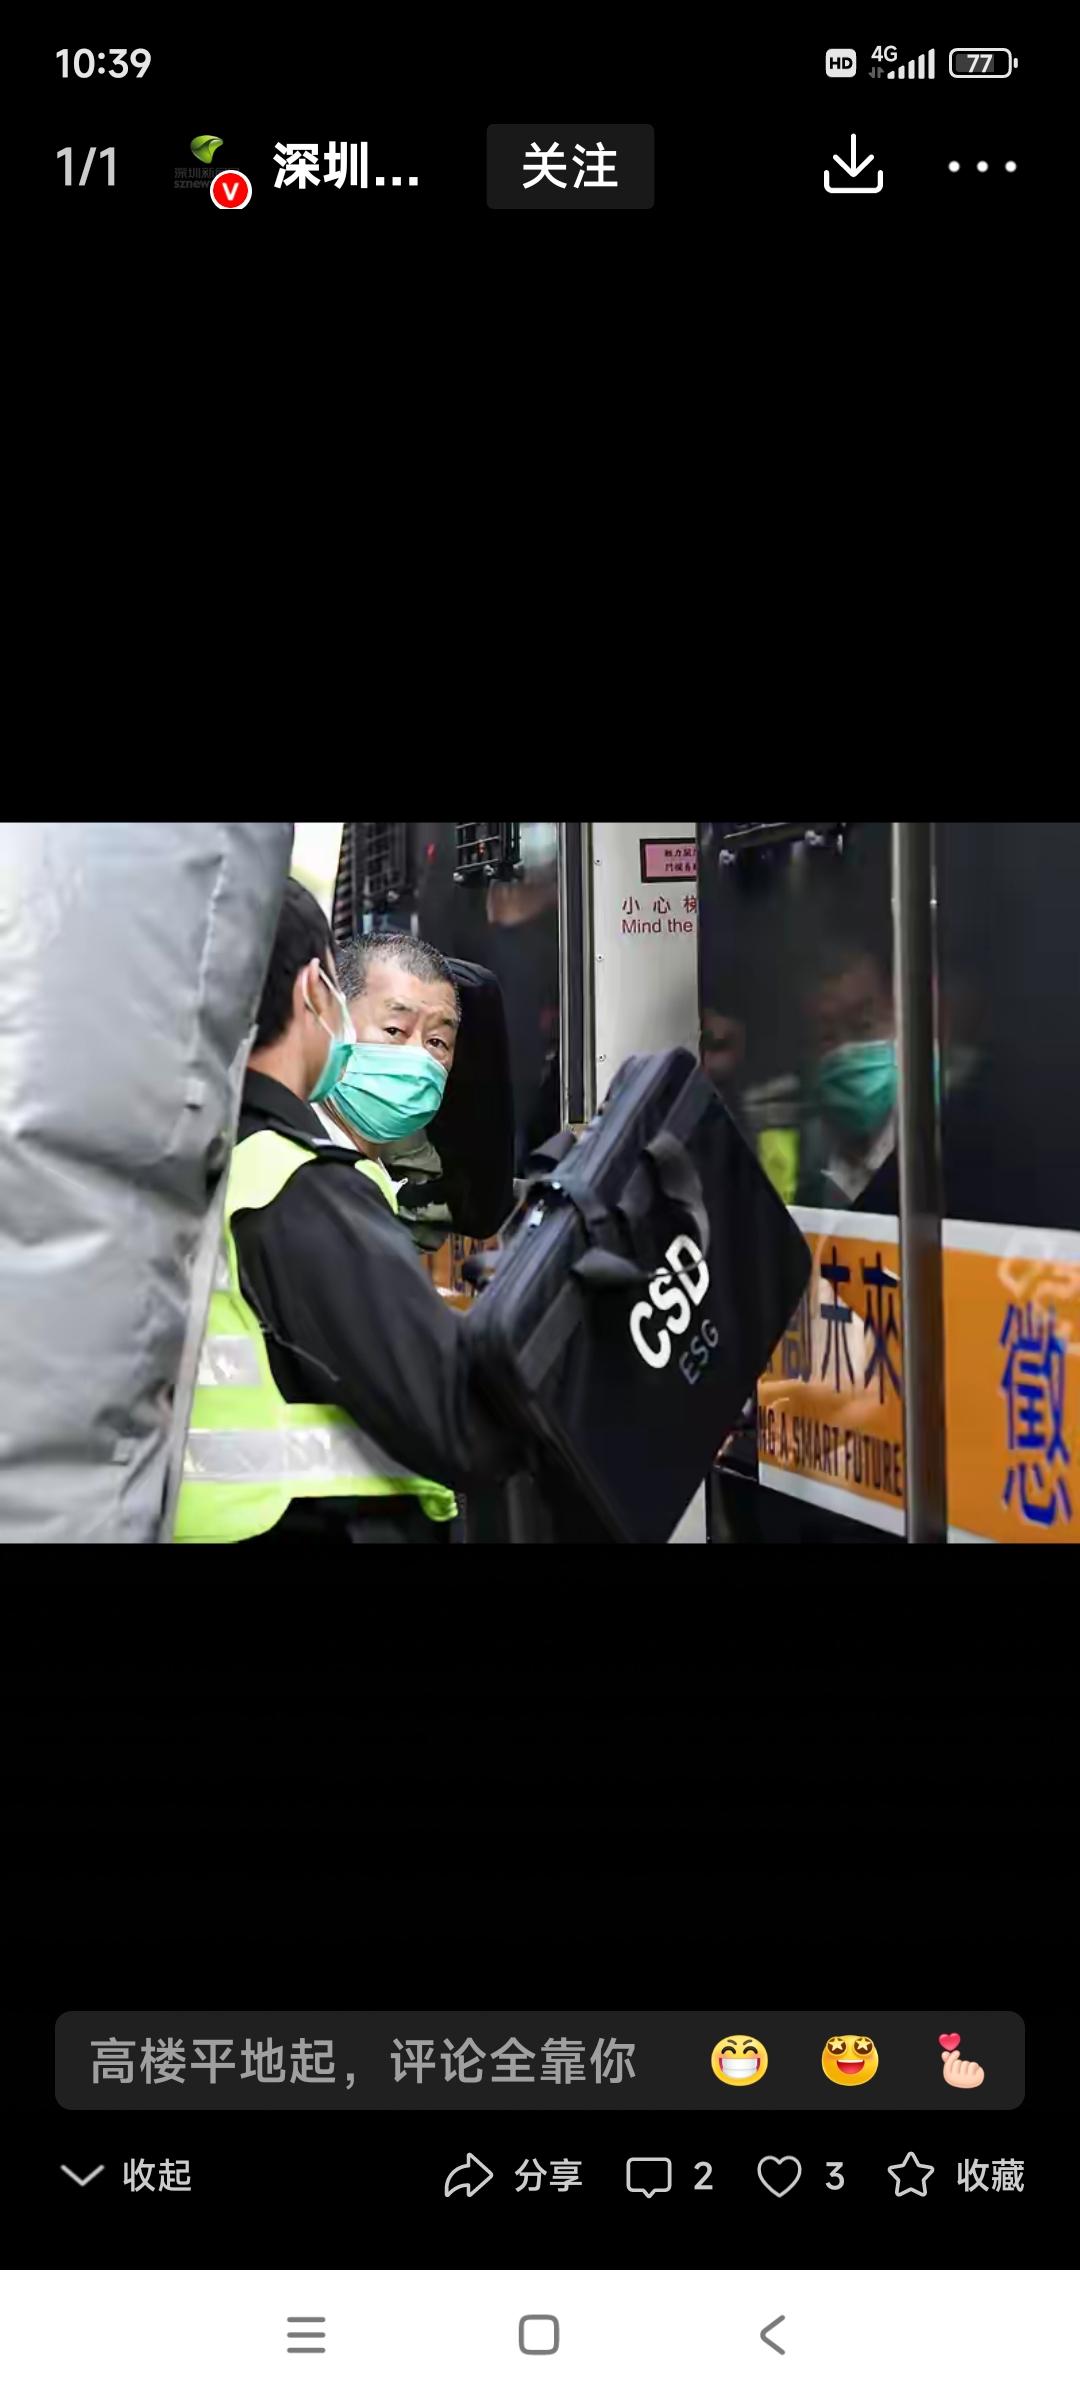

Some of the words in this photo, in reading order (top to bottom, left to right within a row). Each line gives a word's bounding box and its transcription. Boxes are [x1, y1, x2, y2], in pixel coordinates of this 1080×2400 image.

[621, 918, 661, 935] Mind
[667, 918, 693, 933] the
[629, 1233, 710, 1369] CSD
[678, 1318, 719, 1385] ESG
[779, 1417, 791, 1461] A
[792, 1416, 840, 1477] SMART
[844, 1430, 903, 1497] FUTURE
